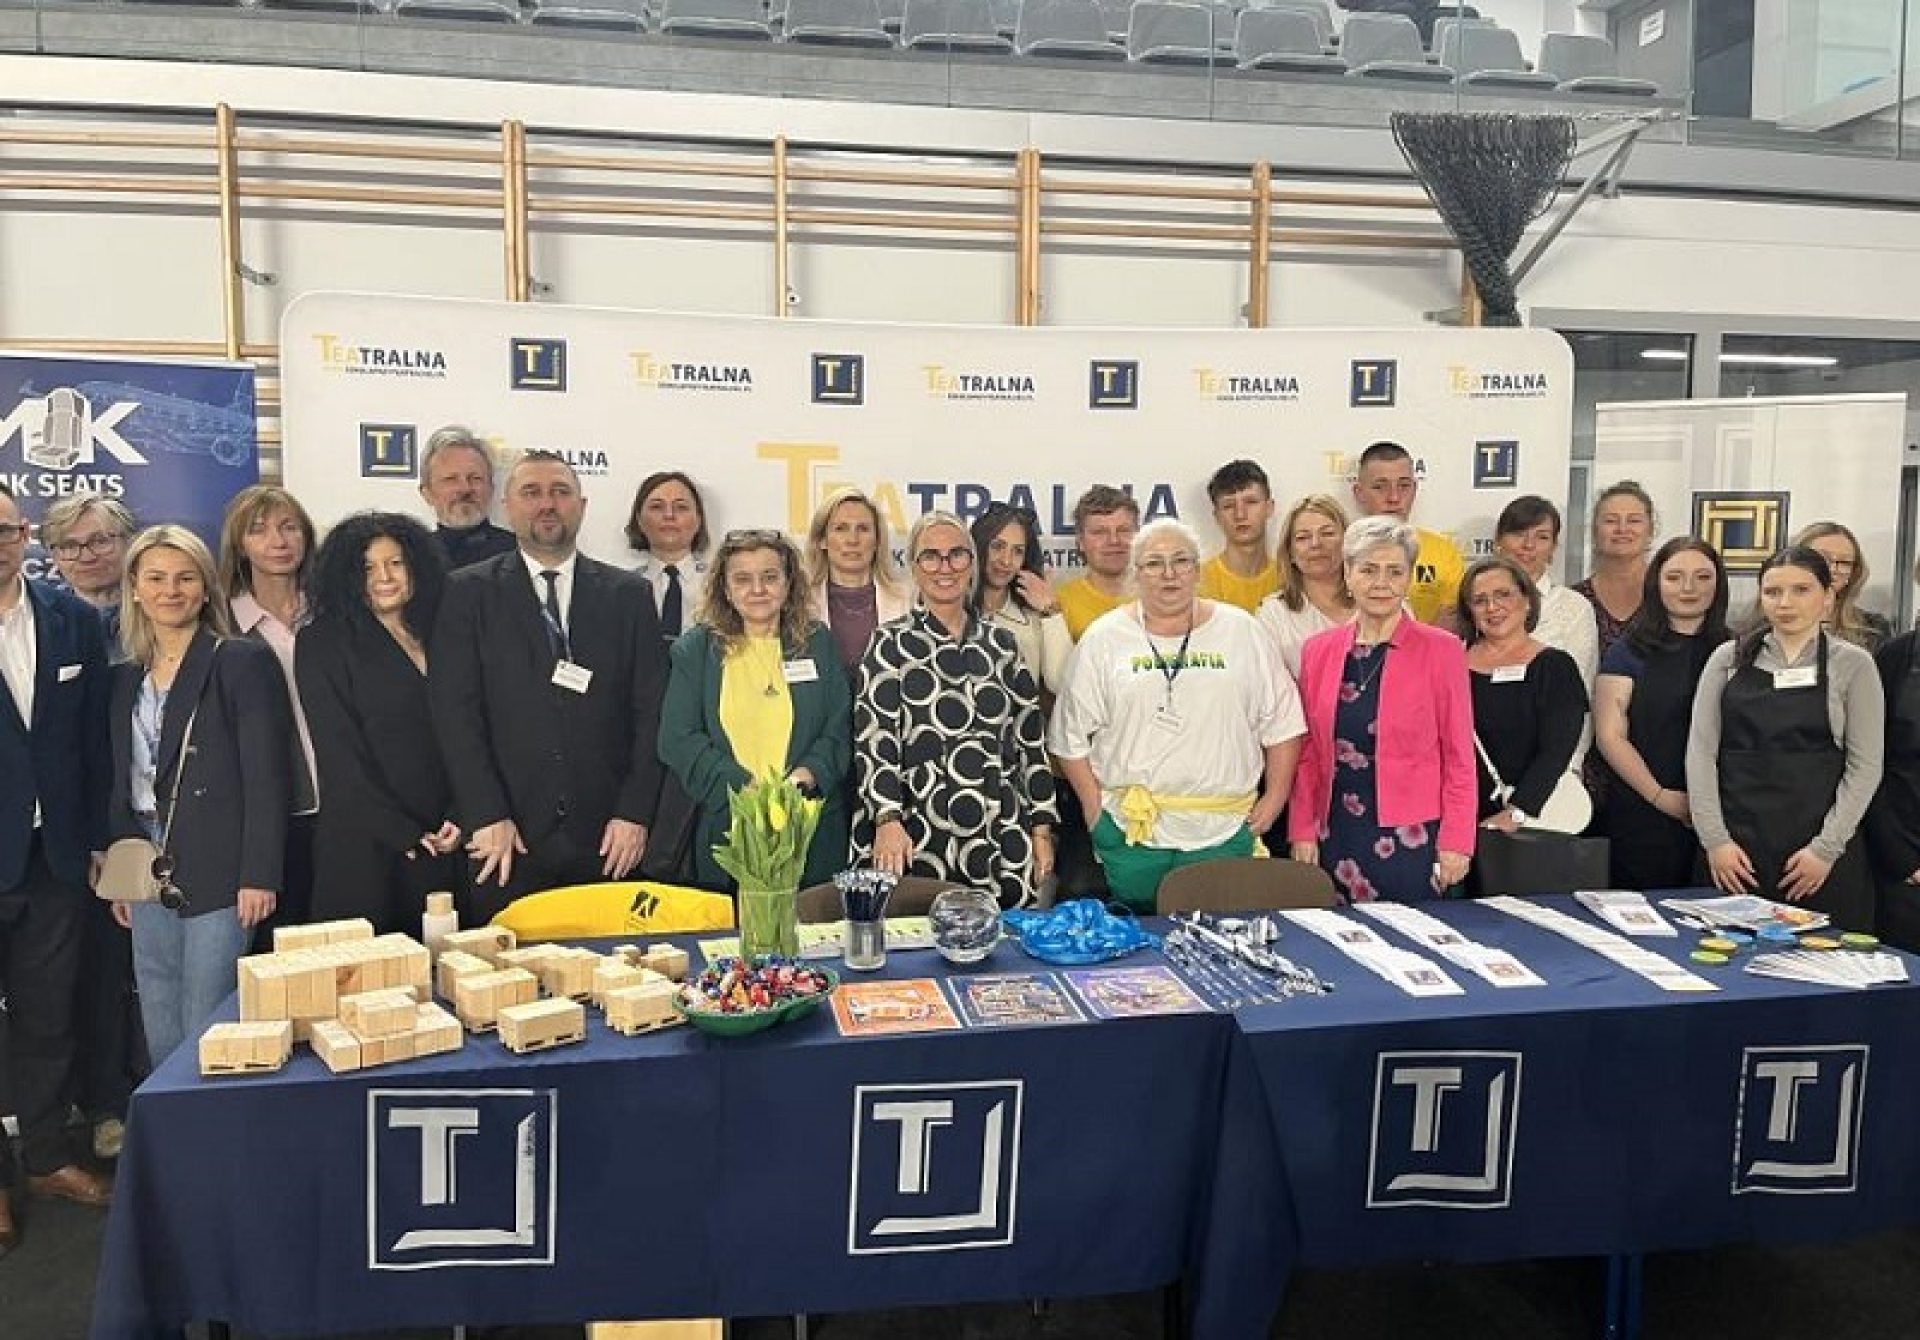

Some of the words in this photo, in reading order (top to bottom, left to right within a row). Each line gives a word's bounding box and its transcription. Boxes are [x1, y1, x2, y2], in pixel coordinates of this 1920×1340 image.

[311, 333, 447, 370] TEATRALNA
[629, 351, 752, 384] TEATRALNA
[921, 364, 1035, 393] TEATRALNA
[1191, 368, 1300, 394] TEATRALNA
[1447, 366, 1548, 390] TEATRALNA
[37, 474, 126, 498] SEATS
[757, 442, 1181, 537] TATRALA
